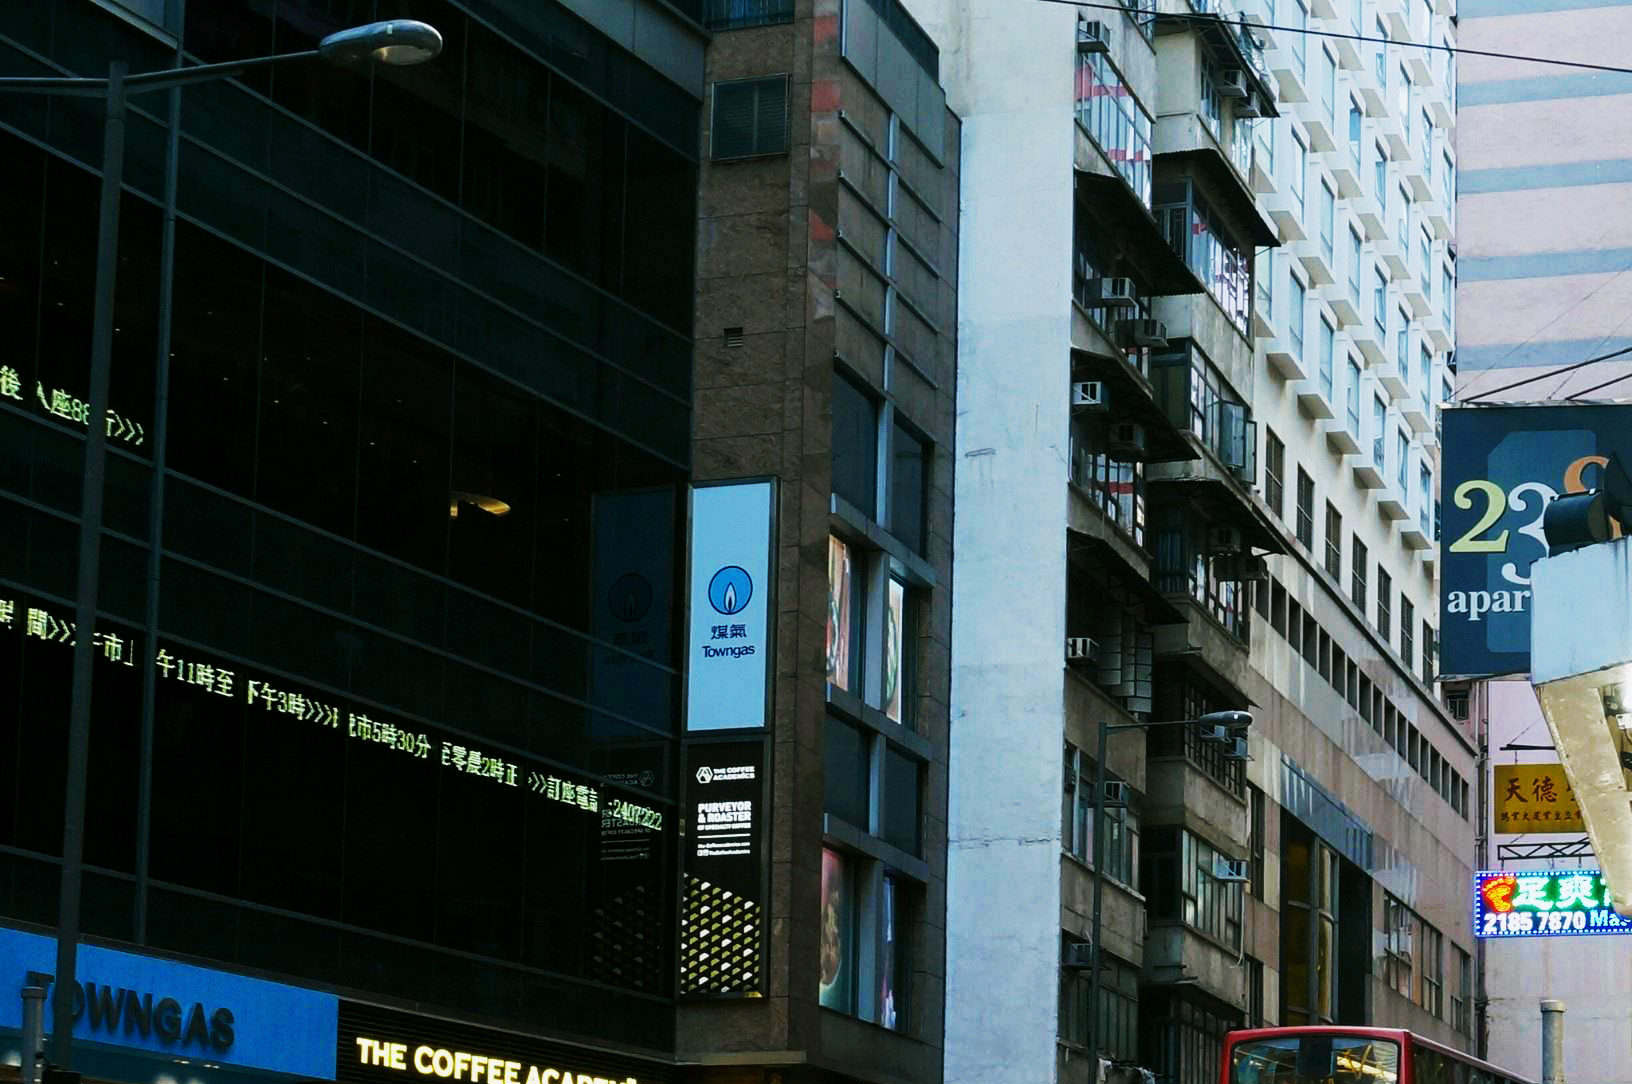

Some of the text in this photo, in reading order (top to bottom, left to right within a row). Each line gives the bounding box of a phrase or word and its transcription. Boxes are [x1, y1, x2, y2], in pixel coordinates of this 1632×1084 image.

[711, 624, 747, 640] 煤氣
[701, 645, 756, 659] Towngas
[698, 801, 751, 813] PURVEYOR
[698, 811, 751, 823] & ROASTER
[1484, 913, 1533, 933] 2185
[1537, 911, 1586, 931] 7870
[357, 1037, 407, 1070] THE
